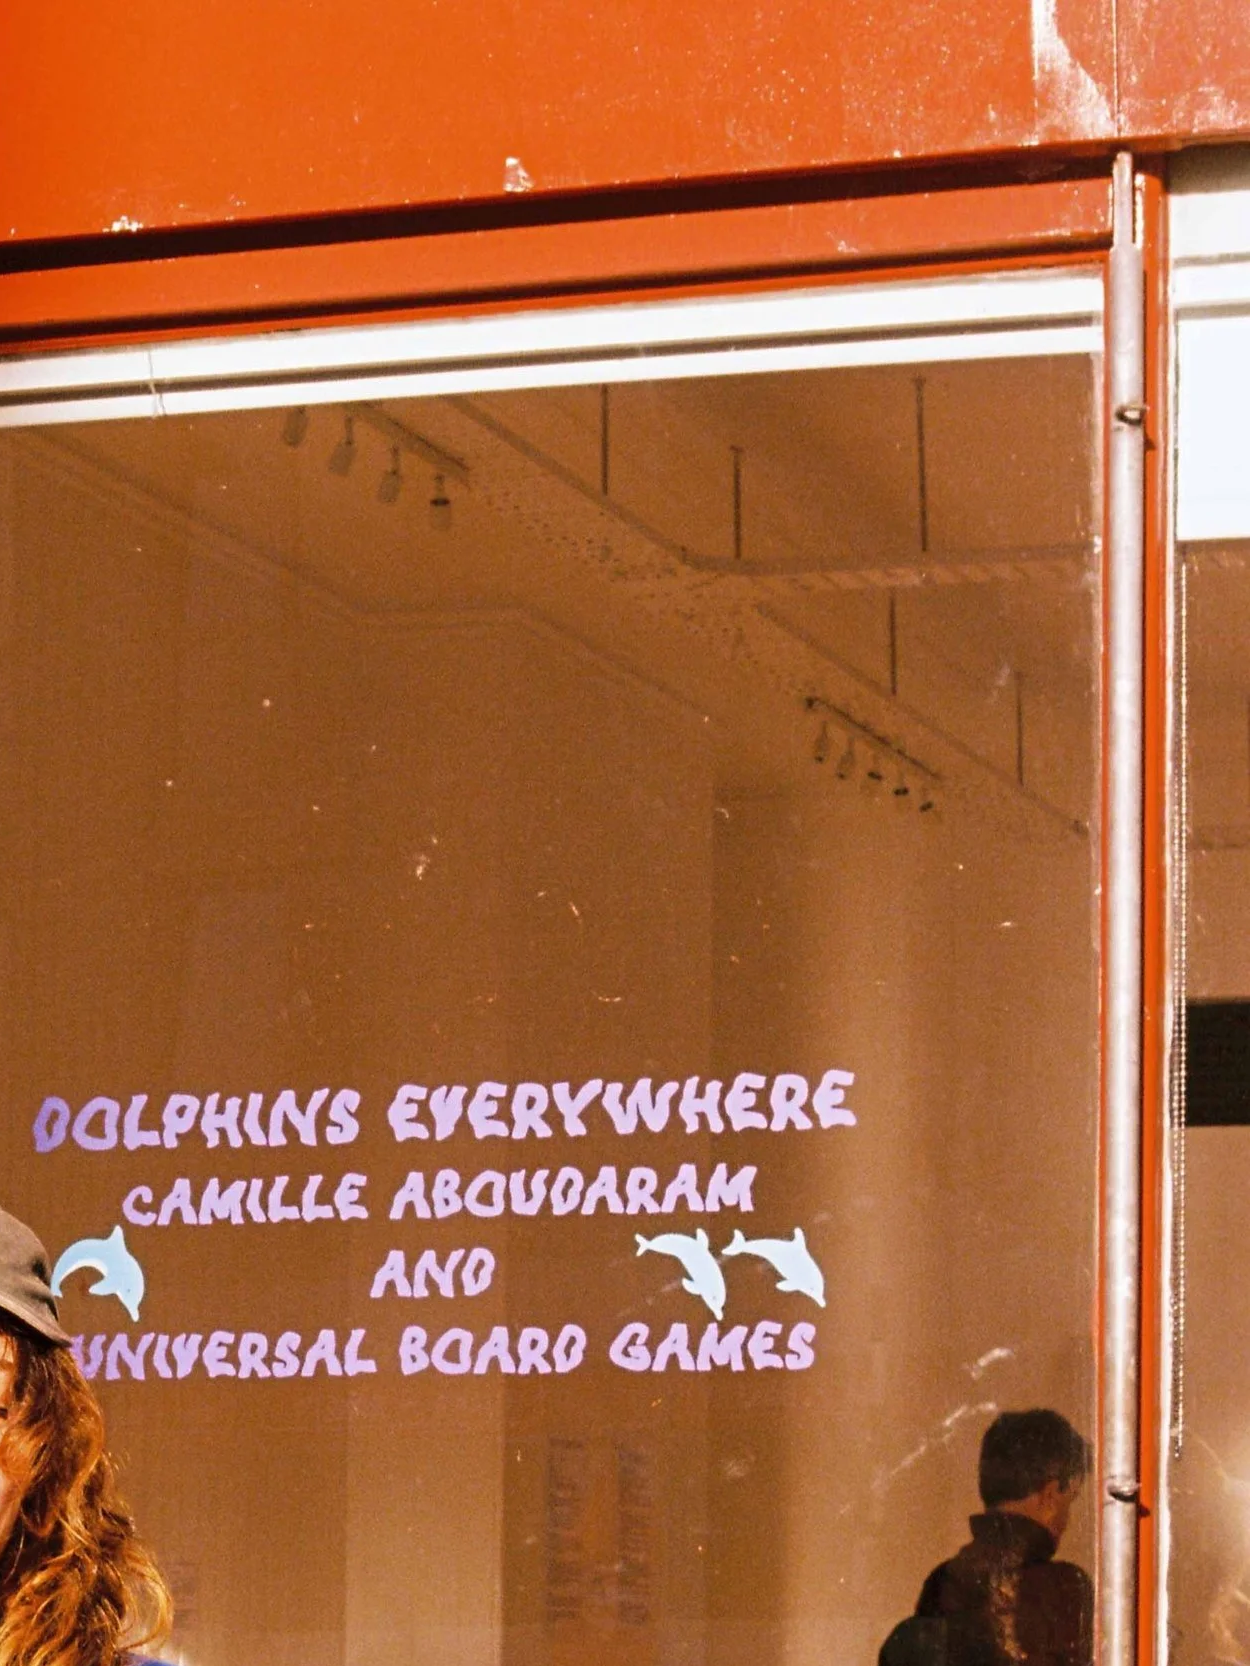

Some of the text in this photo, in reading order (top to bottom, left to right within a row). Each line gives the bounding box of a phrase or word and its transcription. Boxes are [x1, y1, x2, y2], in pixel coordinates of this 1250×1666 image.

[32, 1069, 857, 1153] DOLPHINS EVERYWHERE
[122, 1163, 756, 1227] CAMILLE ABOUDARAM
[369, 1247, 496, 1298] AND
[69, 1319, 816, 1381] UNIVERSAL BOARD GAMES
